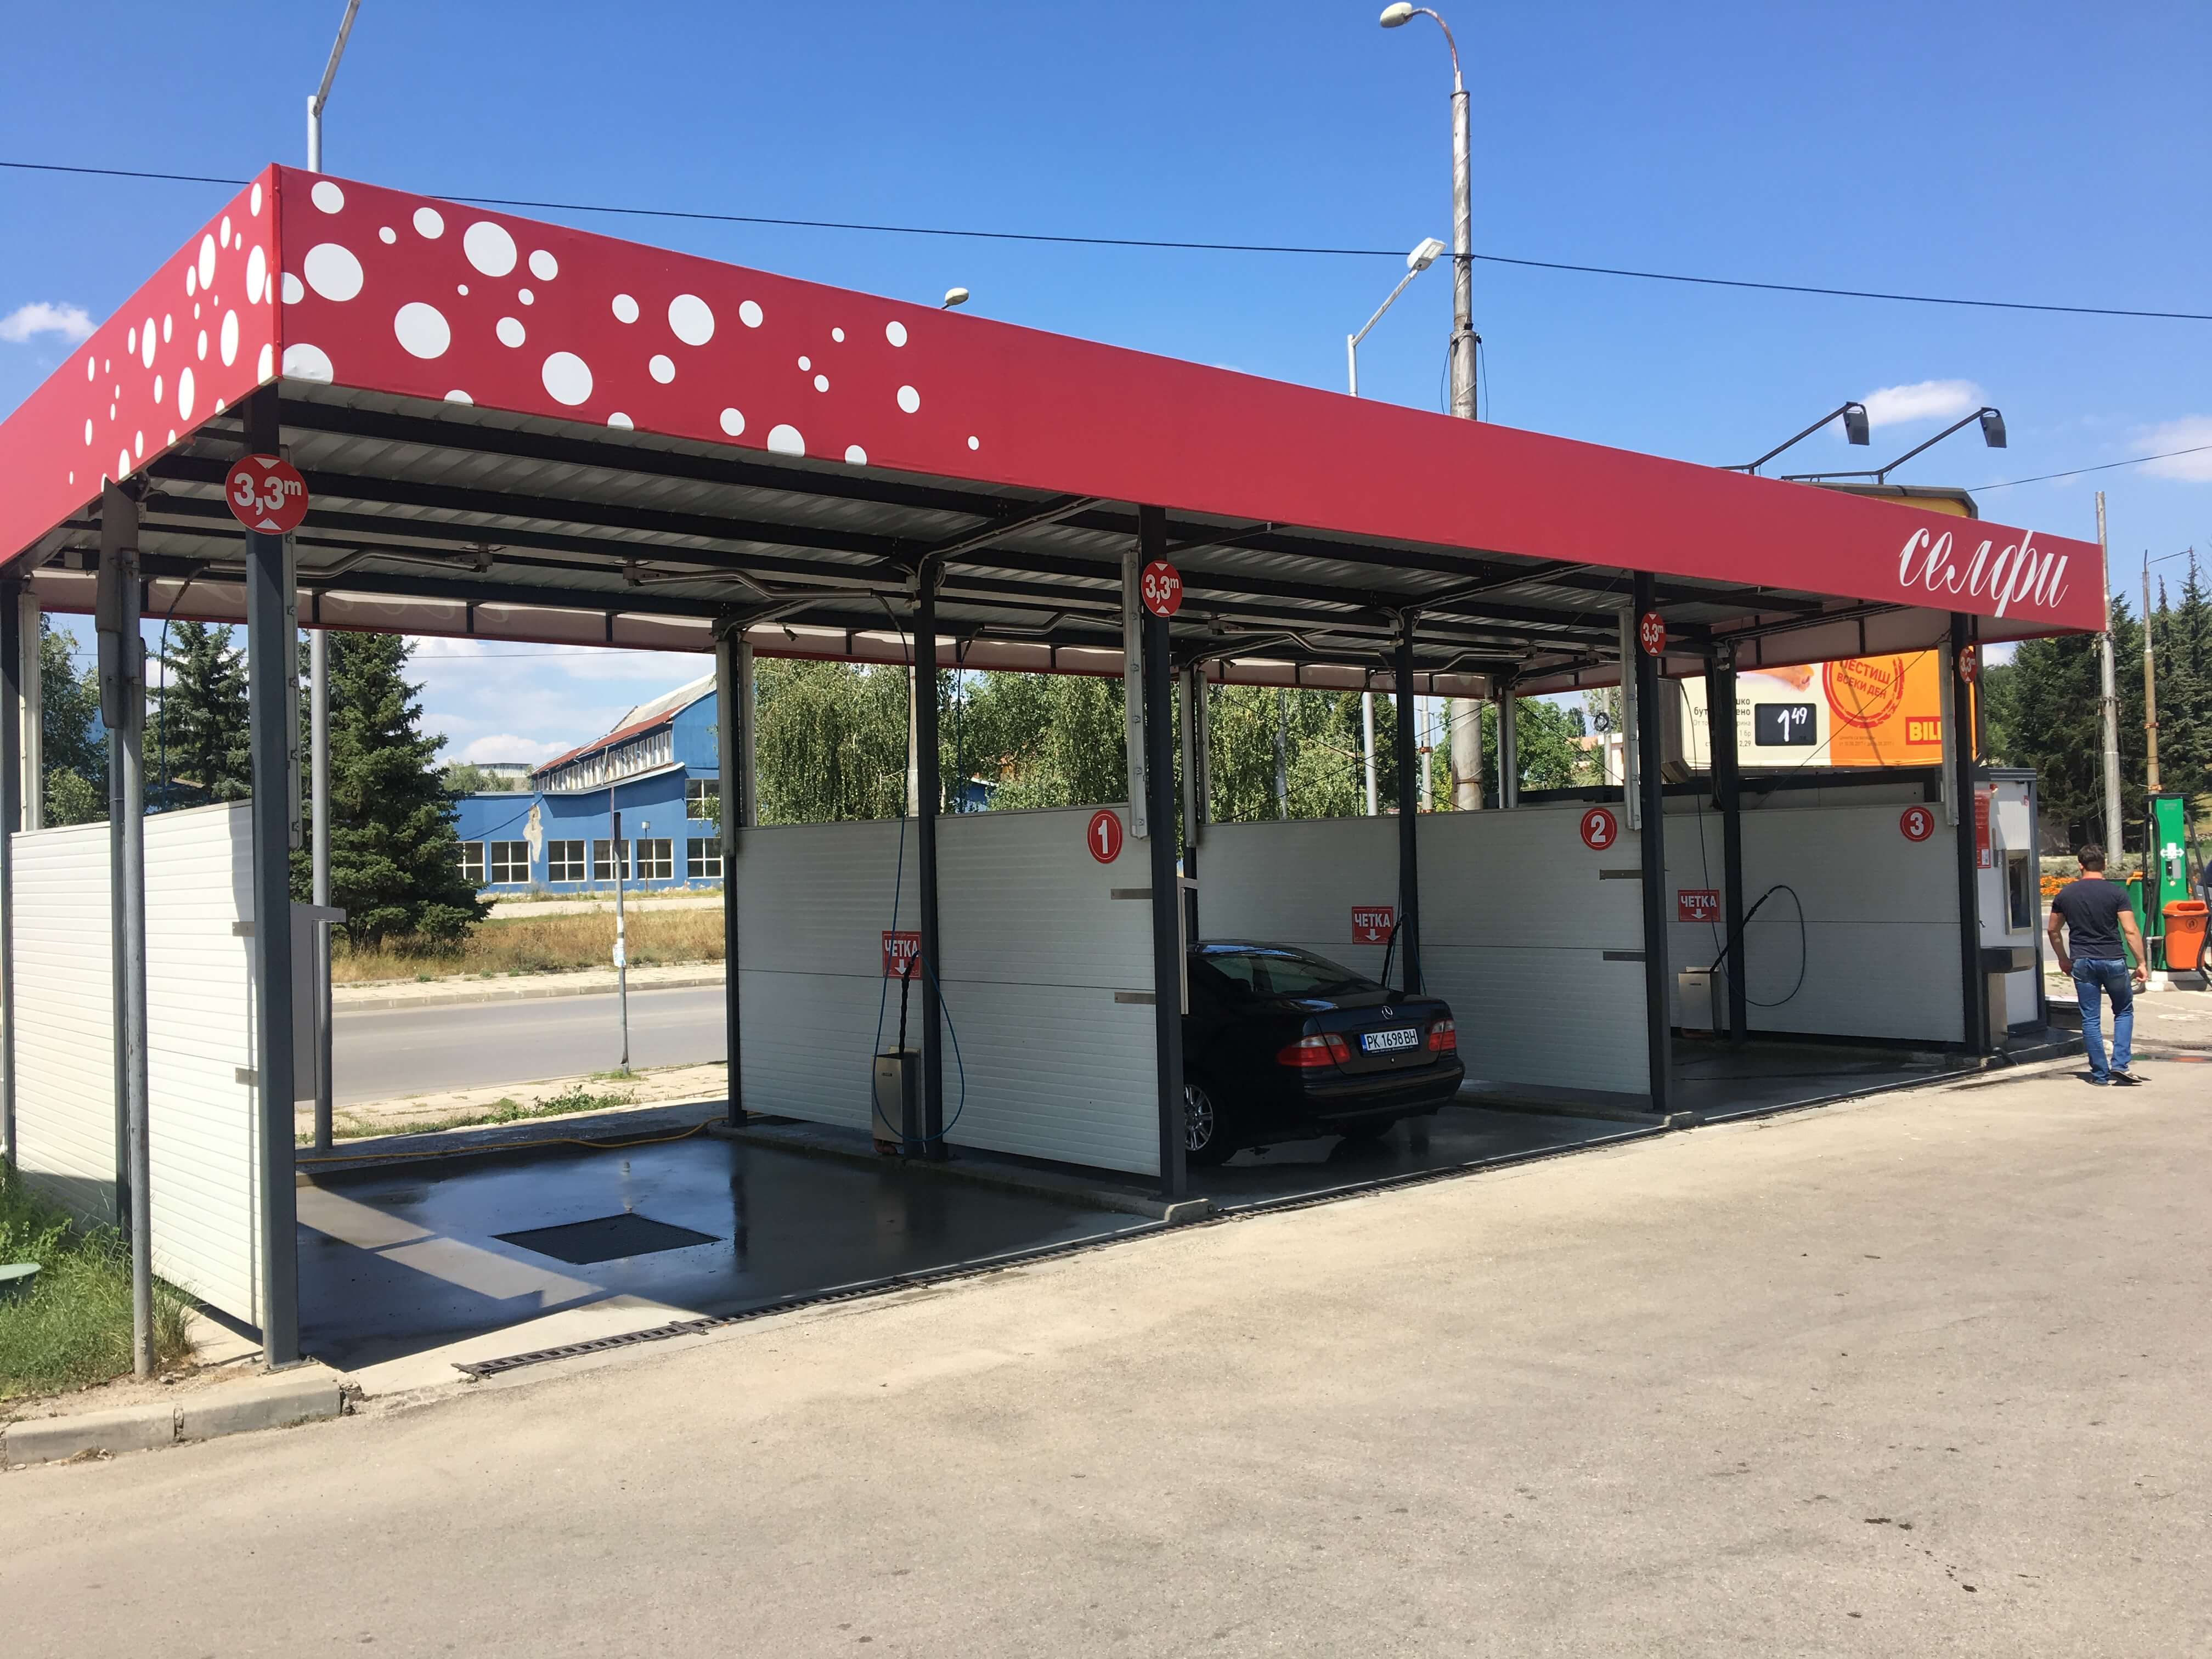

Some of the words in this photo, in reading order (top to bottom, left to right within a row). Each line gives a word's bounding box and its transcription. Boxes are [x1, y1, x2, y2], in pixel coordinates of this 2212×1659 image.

[1591, 815, 1606, 843] 2
[1910, 812, 1924, 836] 3
[1098, 820, 1108, 854] 1
[1680, 895, 1717, 907] ЧЕТКА
[1355, 913, 1391, 927] ЧЕТКА
[885, 939, 919, 957] ЧЕТКА
[1381, 1031, 1404, 1047] 1698
